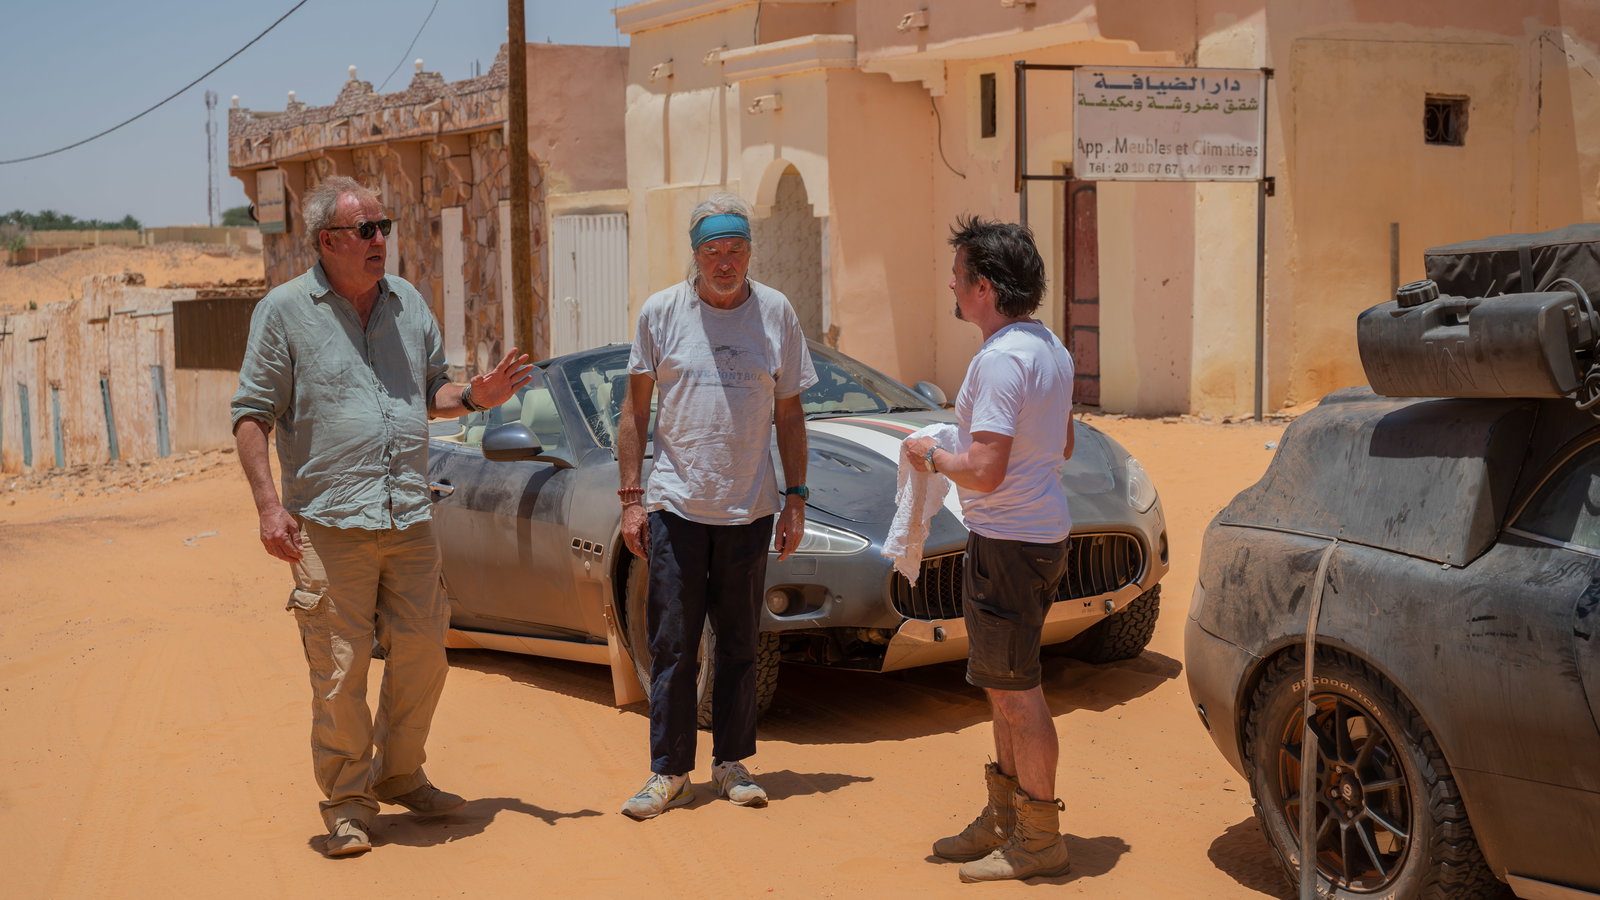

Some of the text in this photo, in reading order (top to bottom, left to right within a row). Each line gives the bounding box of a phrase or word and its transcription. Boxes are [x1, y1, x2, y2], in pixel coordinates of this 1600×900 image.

[1093, 72, 1241, 95] دار الضيافة
[1077, 93, 1259, 114] شقق مفروشة ومكيفة
[1176, 143, 1189, 156] et
[1114, 163, 1129, 174] 20
[1164, 163, 1178, 175] 67
[1237, 165, 1251, 176] 77
